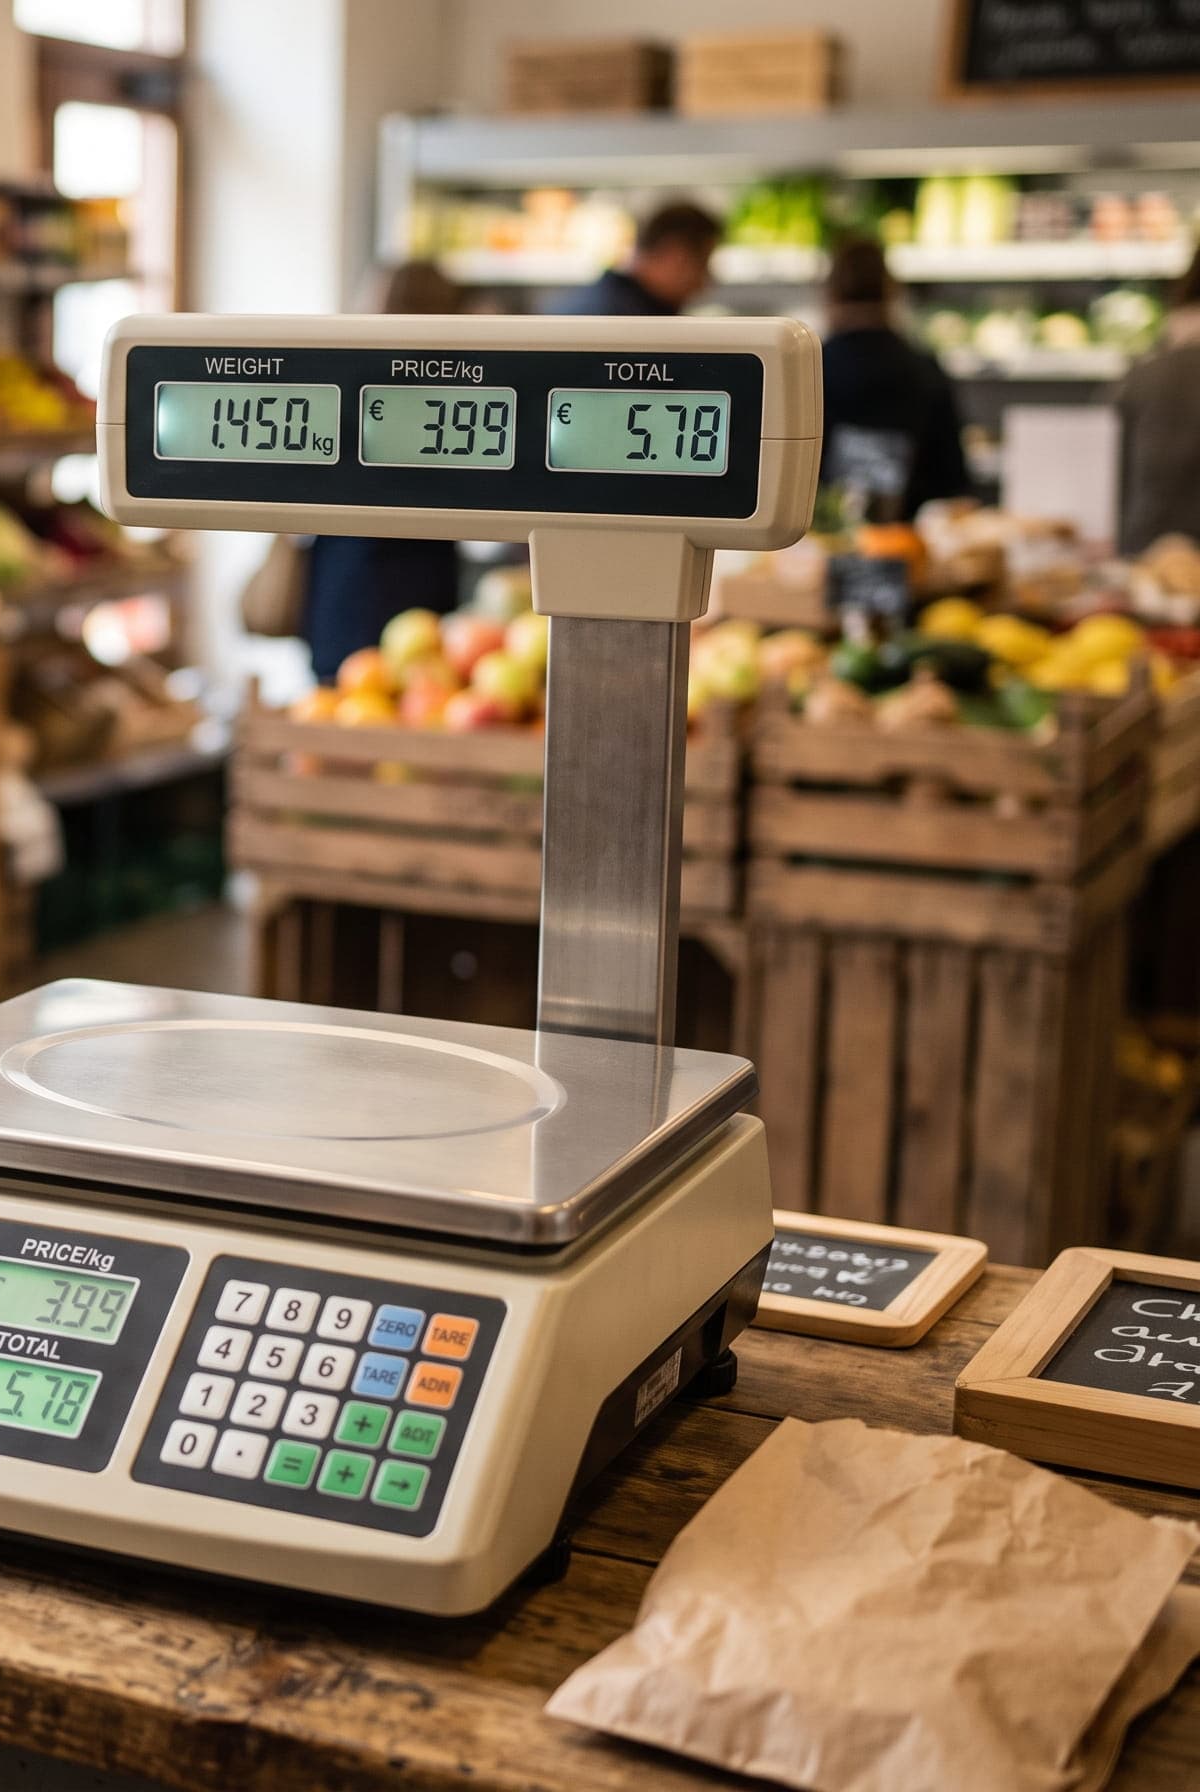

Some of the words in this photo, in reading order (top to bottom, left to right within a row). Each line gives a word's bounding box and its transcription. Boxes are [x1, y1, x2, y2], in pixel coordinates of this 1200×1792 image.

[205, 357, 284, 375] WEIGHT
[391, 360, 484, 383] PRICE/kg
[604, 362, 674, 382] TOTAL
[211, 397, 309, 451] 1.450
[312, 432, 334, 456] kg
[368, 399, 385, 422] €
[419, 399, 509, 456] 3.99
[556, 402, 572, 425] €
[626, 403, 721, 462] 5.78
[20, 1238, 115, 1272] PRICE/kg
[35, 1279, 126, 1332] 3.99
[235, 1291, 253, 1313] 7
[283, 1299, 302, 1322] 8
[334, 1308, 353, 1330] 9
[376, 1319, 417, 1337] ZERO
[214, 1337, 233, 1358] 4
[432, 1327, 470, 1347] TARE
[266, 1346, 286, 1369] 5
[317, 1356, 337, 1378] 6
[363, 1365, 400, 1386] TARE
[201, 1385, 213, 1407] 1
[247, 1394, 267, 1417] 2
[299, 1403, 319, 1426] 3
[179, 1433, 198, 1456] 0
